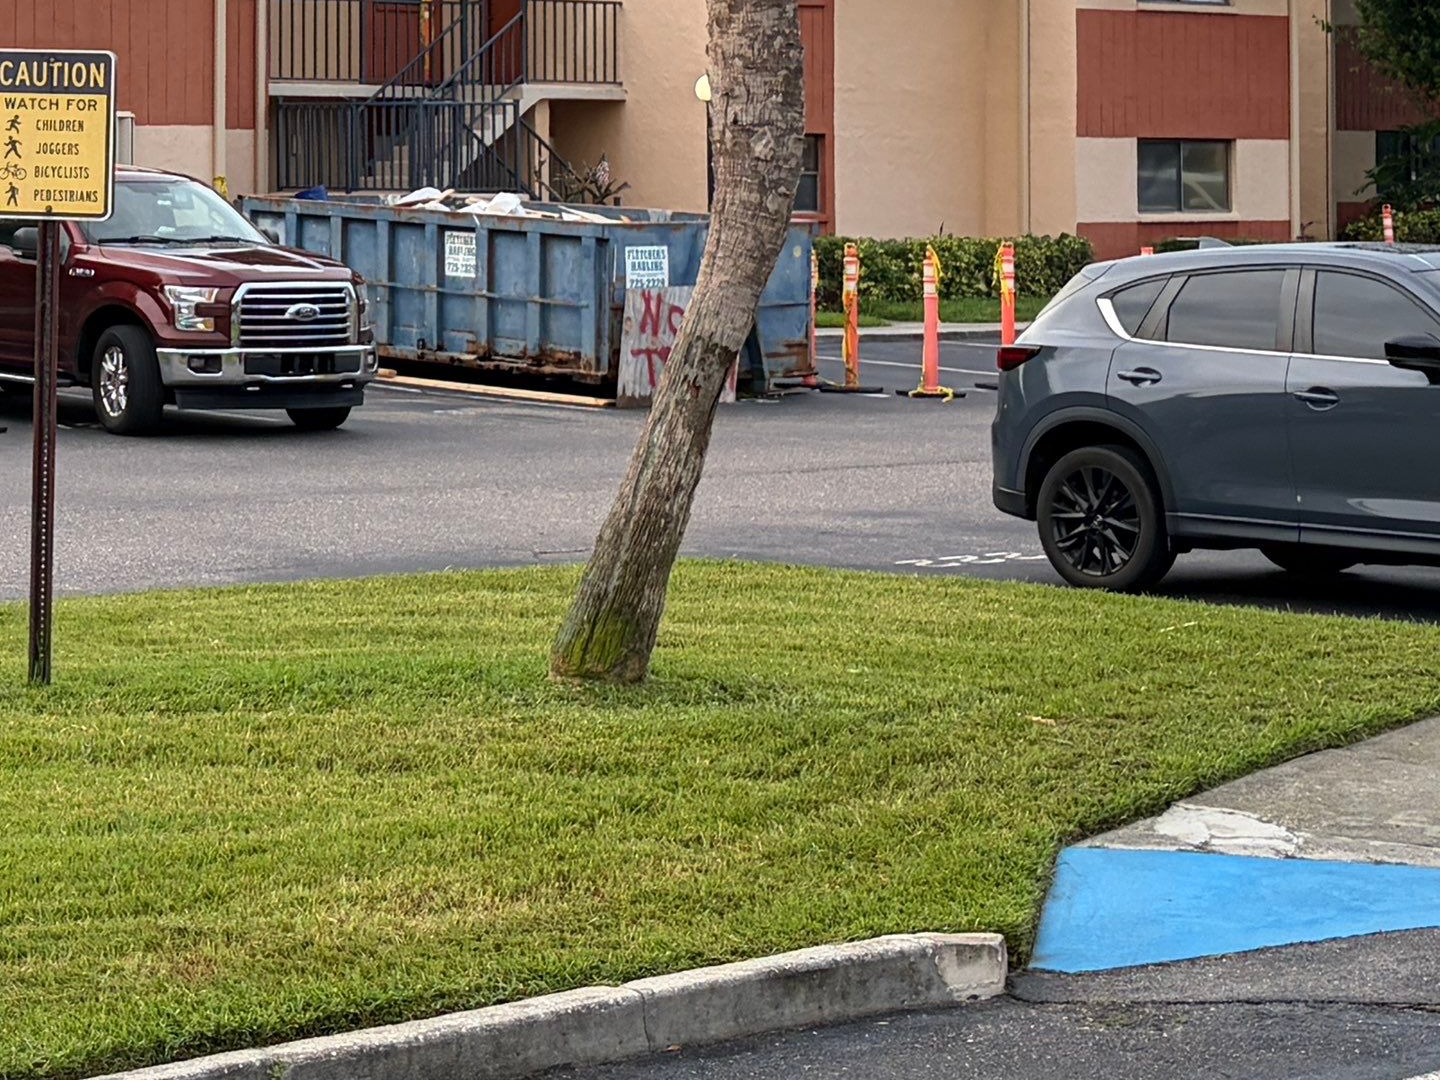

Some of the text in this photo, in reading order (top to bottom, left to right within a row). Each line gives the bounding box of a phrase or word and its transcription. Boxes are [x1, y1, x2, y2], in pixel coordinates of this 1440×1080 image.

[0, 60, 105, 88] CAUTION
[4, 97, 98, 112] WATCH FOR
[35, 119, 84, 132] CHILDREN
[35, 142, 80, 156] JOGGERS
[34, 165, 90, 179] BICYCLISTS
[33, 188, 99, 203] PEDESTRIANS
